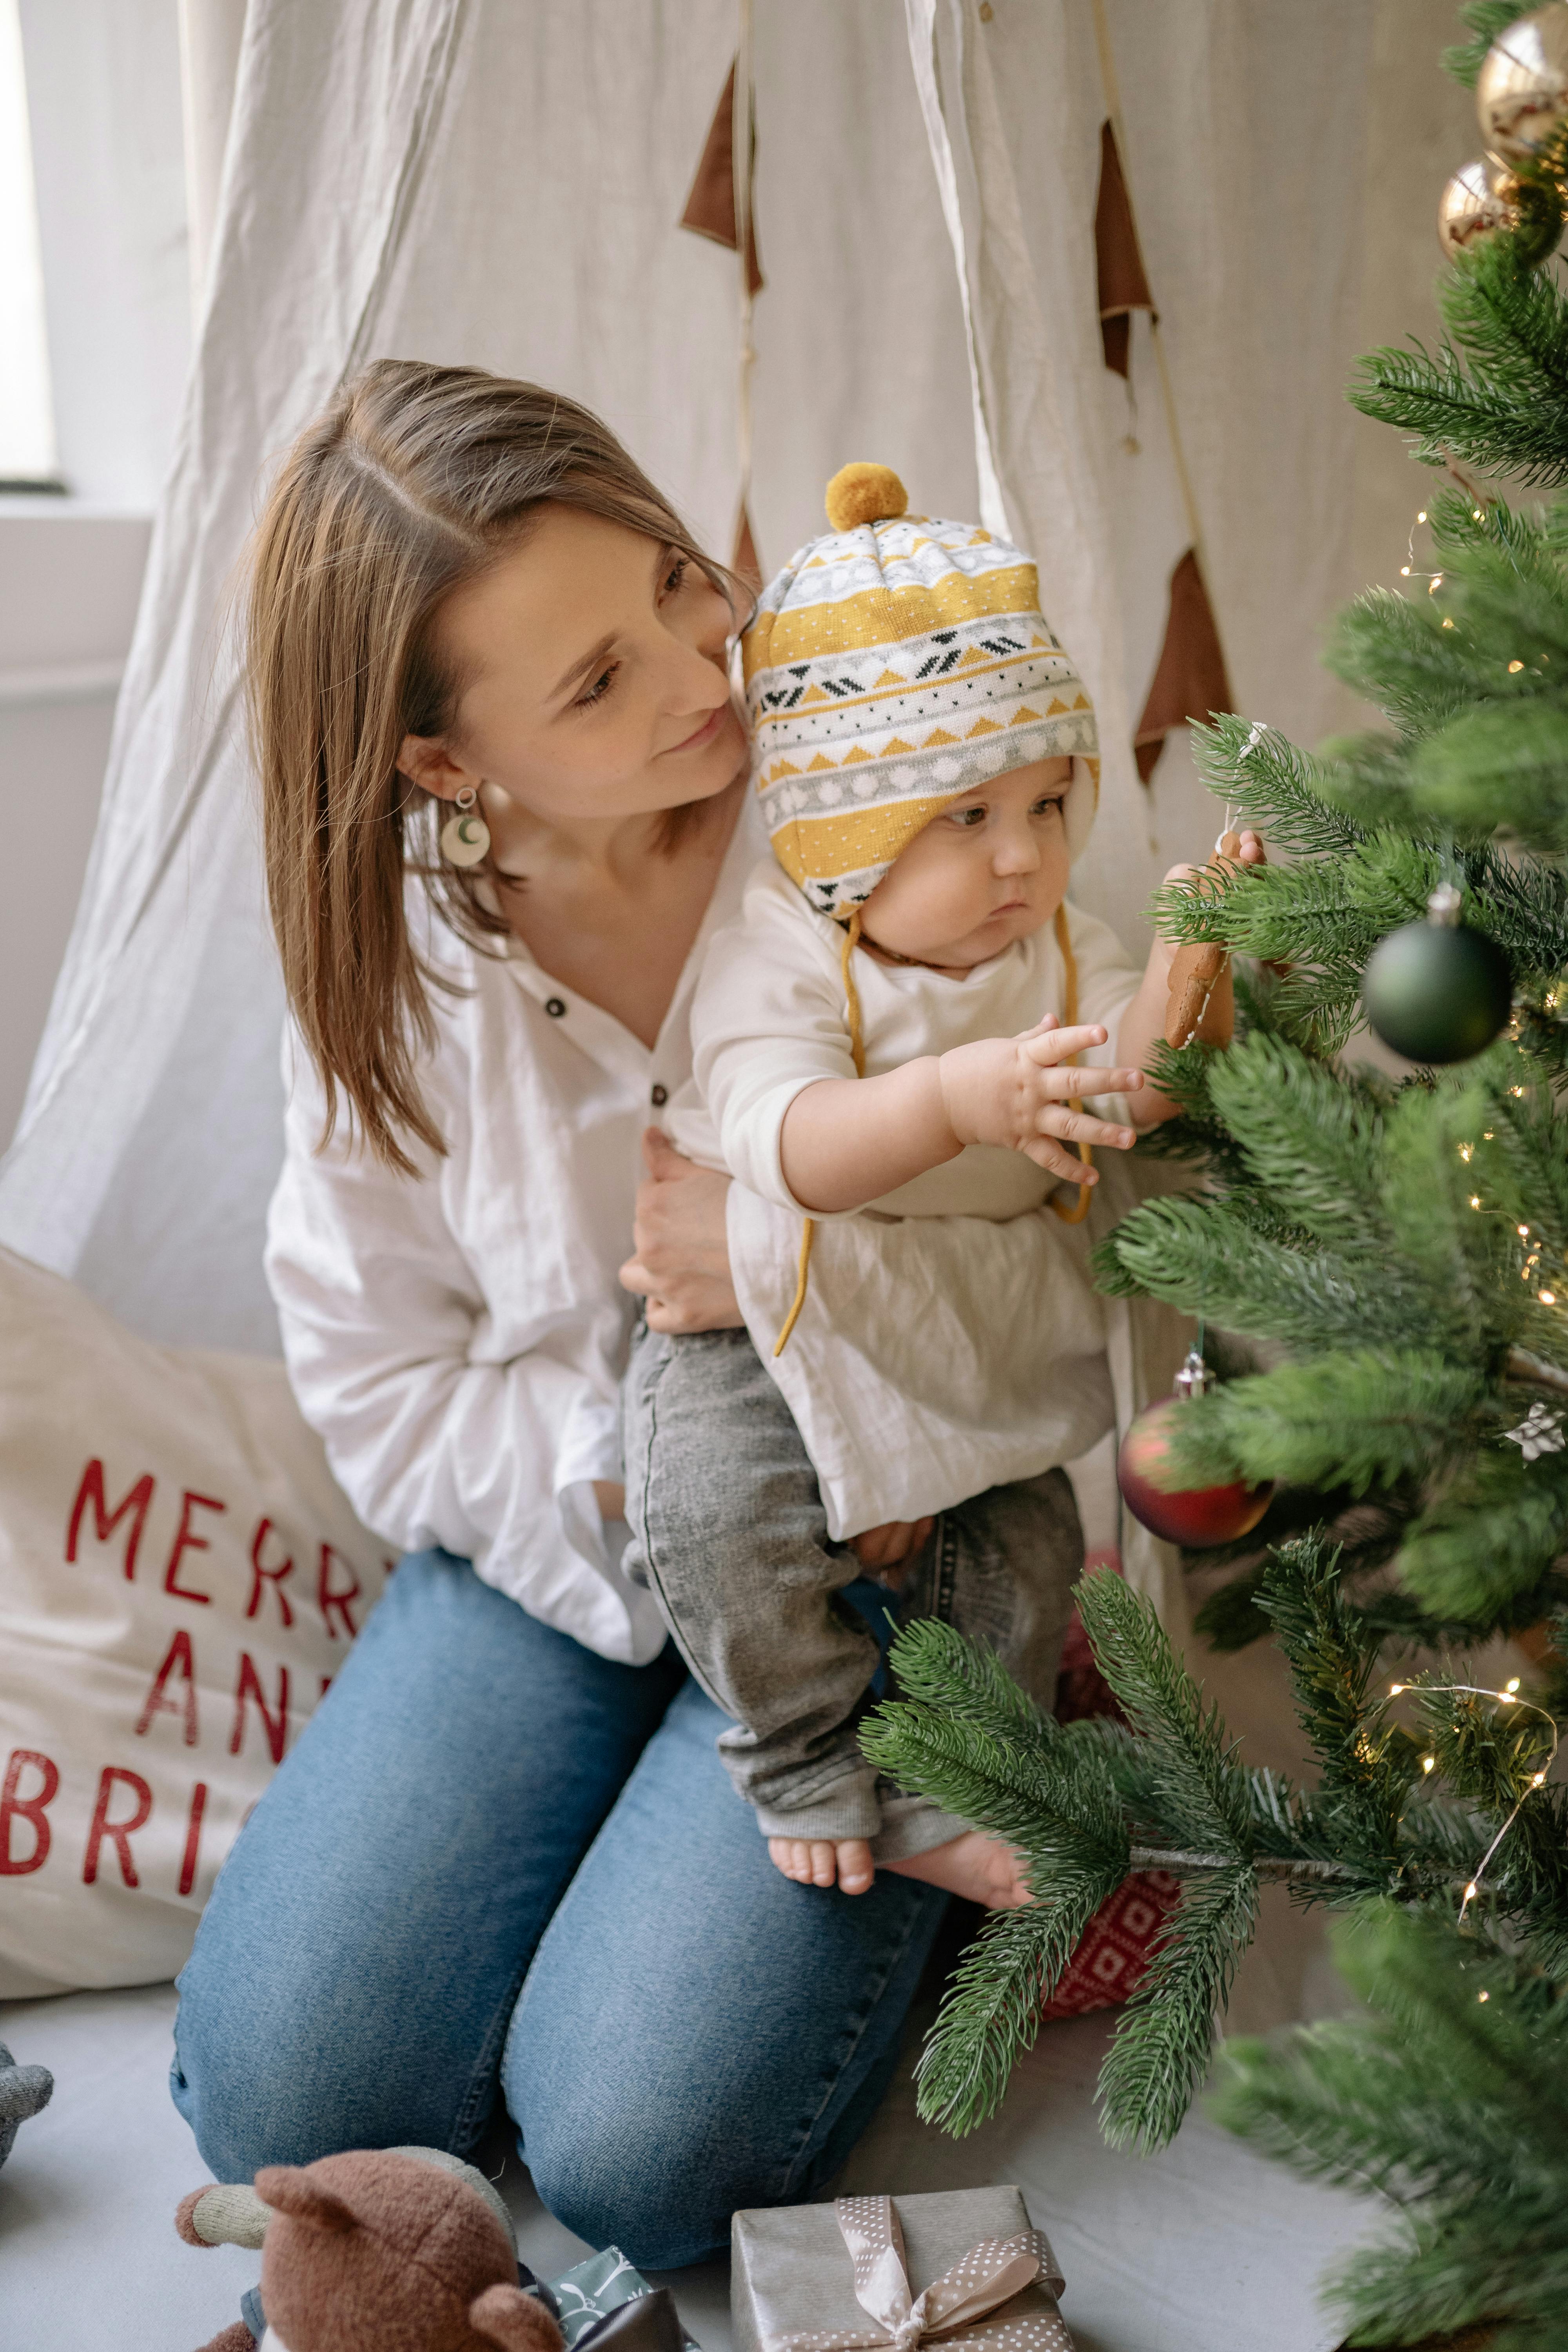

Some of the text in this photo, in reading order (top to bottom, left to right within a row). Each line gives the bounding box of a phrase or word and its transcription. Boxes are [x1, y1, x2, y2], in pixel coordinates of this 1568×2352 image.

[65, 1459, 395, 1640] MERR
[135, 1630, 333, 1765] AN
[0, 1749, 257, 1896] BRI
